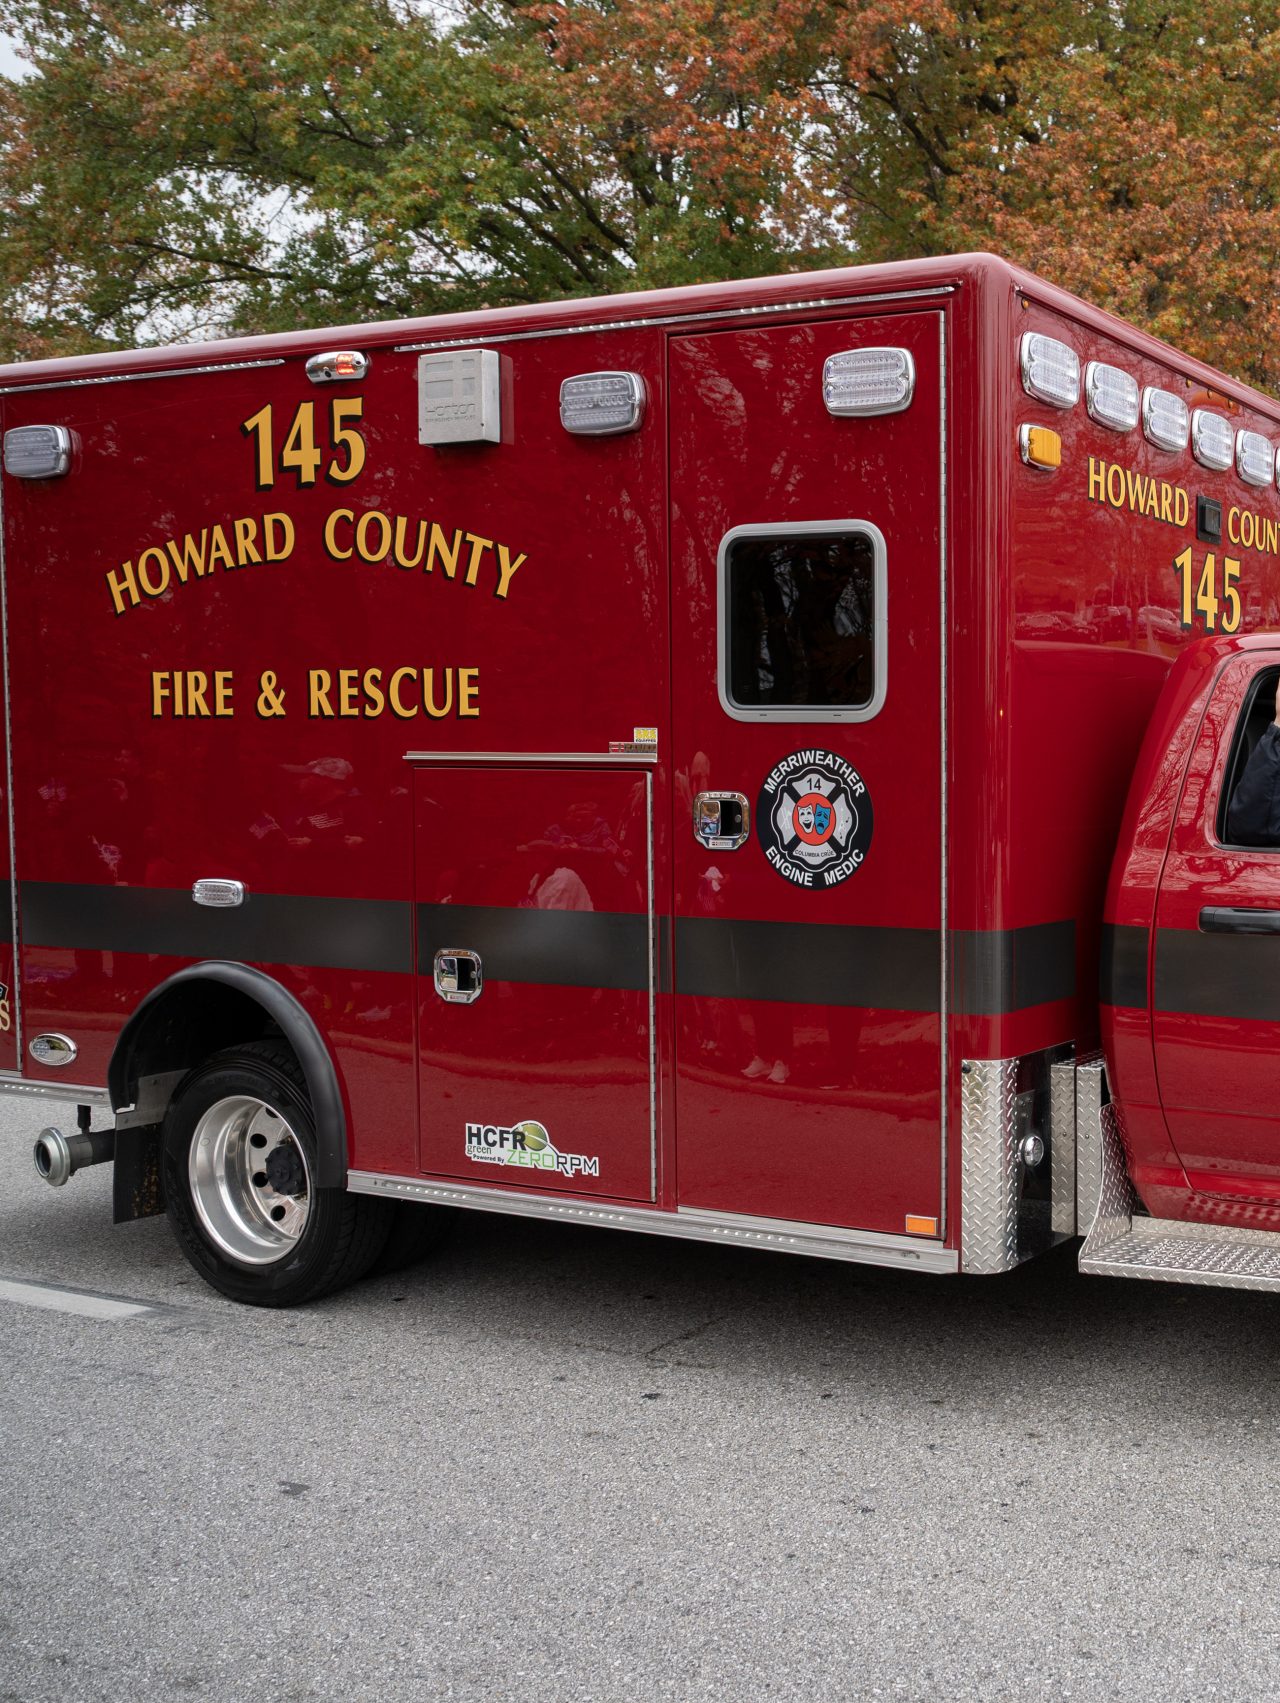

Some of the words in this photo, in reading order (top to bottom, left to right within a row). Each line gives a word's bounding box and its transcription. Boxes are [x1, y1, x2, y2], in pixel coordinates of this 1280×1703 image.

[242, 397, 366, 486] 145
[1087, 456, 1189, 528] HOWARD
[105, 512, 296, 615] HOWARD
[324, 508, 528, 599] COUNTY
[1174, 546, 1242, 634] 145
[151, 670, 235, 717] FIRE
[255, 669, 287, 718] &
[308, 666, 481, 719] RESCUE
[763, 750, 866, 798] MERRIWEATHER
[806, 778, 823, 791] 14
[765, 846, 814, 886] ENGINE
[823, 848, 864, 886] MEDIC
[794, 849, 820, 858] COLUMBIA
[466, 1144, 492, 1155] green
[467, 1125, 526, 1151] HCFR
[472, 1154, 496, 1162] Powered
[497, 1156, 505, 1164] By
